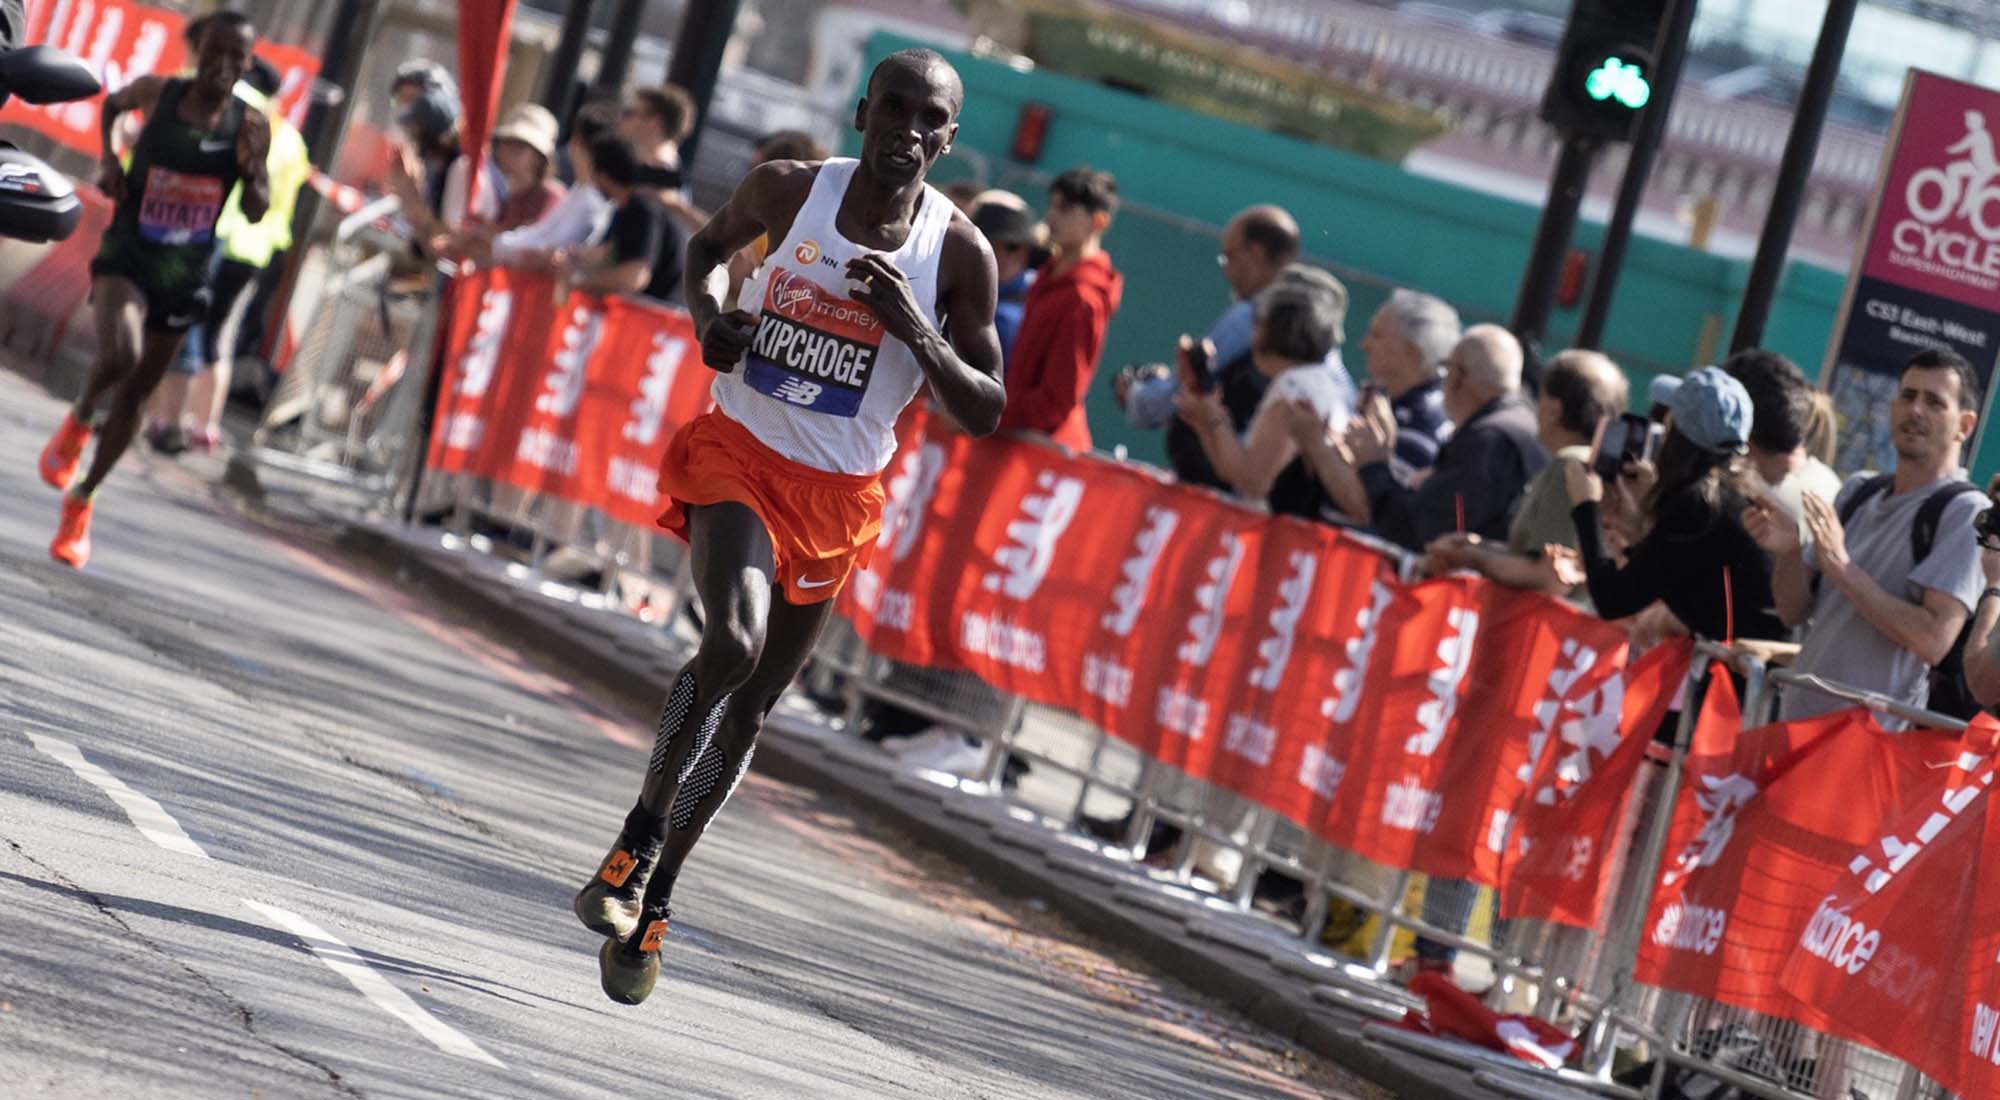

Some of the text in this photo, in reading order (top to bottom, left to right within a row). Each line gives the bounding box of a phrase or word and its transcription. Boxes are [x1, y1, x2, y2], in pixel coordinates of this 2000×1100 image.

[820, 255, 839, 269] NN
[1893, 219, 2000, 277] CYCLE
[774, 273, 880, 331] Virgin money
[752, 315, 872, 387] KIPCHOGE
